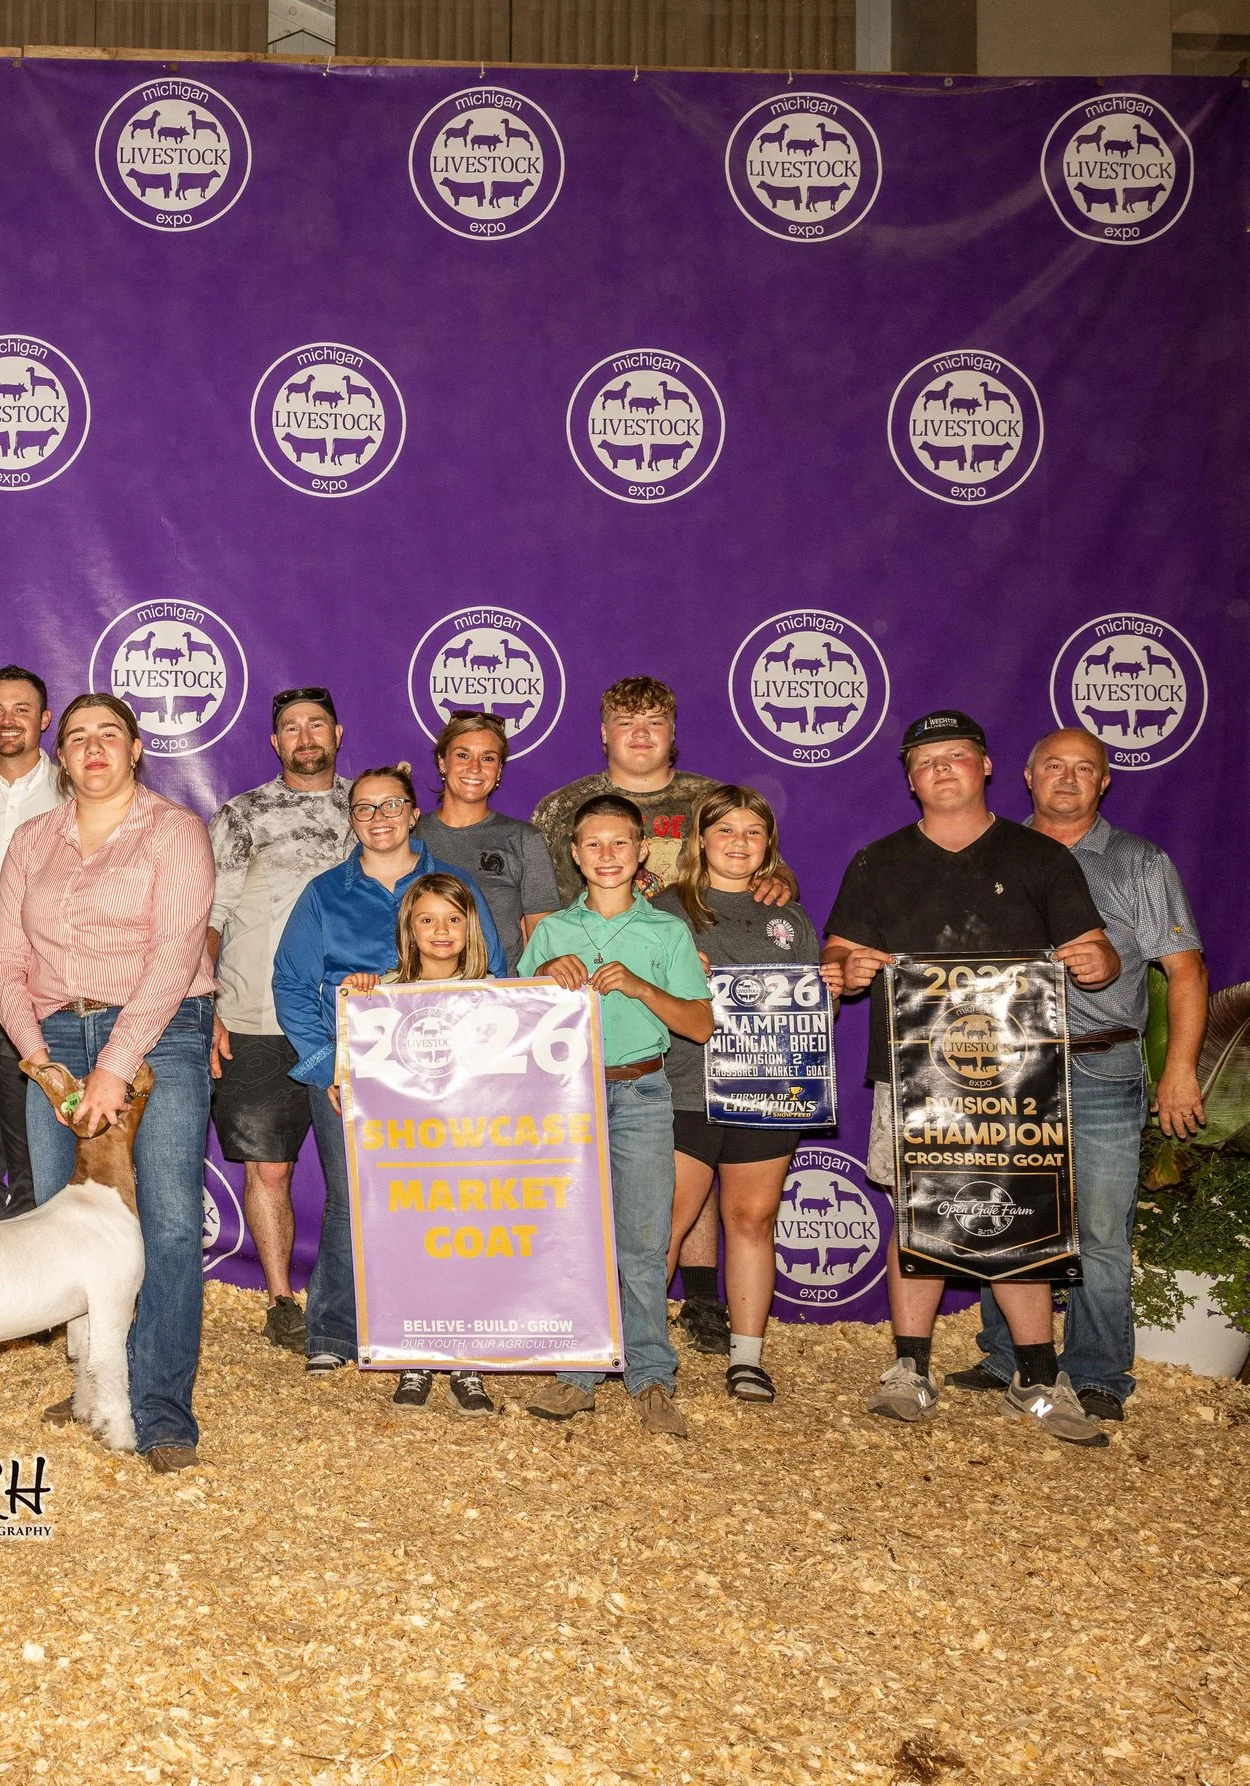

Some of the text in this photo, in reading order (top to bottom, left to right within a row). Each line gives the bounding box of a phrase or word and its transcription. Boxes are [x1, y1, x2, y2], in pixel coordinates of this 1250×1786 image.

[142, 81, 209, 104] michigan
[455, 89, 522, 112] michigan
[770, 93, 838, 116] michigan
[1084, 95, 1154, 118] michigan
[119, 147, 227, 166] LIVESTOCK
[433, 156, 541, 174] LIVESTOCK
[749, 160, 858, 179] LIVESTOCK
[1066, 161, 1173, 180] LIVESTOCK
[155, 213, 193, 228] expo
[468, 220, 507, 237] expo
[788, 224, 825, 239] expo
[1103, 226, 1140, 241] expo
[296, 346, 364, 369] michigan
[612, 350, 681, 373] michigan
[932, 351, 1001, 374] michigan
[274, 410, 382, 432] LIVESTOCK
[591, 418, 701, 436] LIVESTOCK
[912, 419, 1021, 438] LIVESTOCK
[311, 478, 348, 494] expo
[628, 485, 666, 500] expo
[949, 484, 988, 500] expo
[136, 602, 207, 626] michigan
[453, 610, 522, 632] michigan
[775, 613, 844, 635] michigan
[1094, 615, 1164, 638] michigan
[112, 668, 226, 691] LIVESTOCK
[432, 676, 541, 695] LIVESTOCK
[753, 680, 865, 699] LIVESTOCK
[1074, 683, 1183, 702] LIVESTOCK
[150, 736, 189, 753] expo
[792, 748, 831, 763] expo
[1114, 751, 1151, 767] expo
[790, 1034, 827, 1053] BRED
[944, 1041, 1014, 1053] LIVESTOCK
[735, 1053, 803, 1065] DIVISION 2
[765, 1065, 800, 1077] MARKET
[806, 1065, 828, 1077] GOAT
[968, 1080, 992, 1089] expo
[730, 1093, 790, 1101] FORMULA OF
[925, 1096, 1037, 1115] DIVISION 2
[361, 1113, 593, 1150] SHOWCASE
[903, 1121, 1064, 1146] CHAMPION
[903, 1151, 1065, 1167] CROSSBRED GOAT
[388, 1176, 573, 1213] MARKET
[937, 1200, 1036, 1218] Open Gate Farm
[775, 1221, 878, 1240] IVESTOCK
[423, 1225, 538, 1259] GOAT
[800, 1287, 839, 1302] expo
[403, 1320, 573, 1332] BELIEVE BUILD GROW
[400, 1338, 578, 1350] OUR YOUTH, OUR AGRICULTURE
